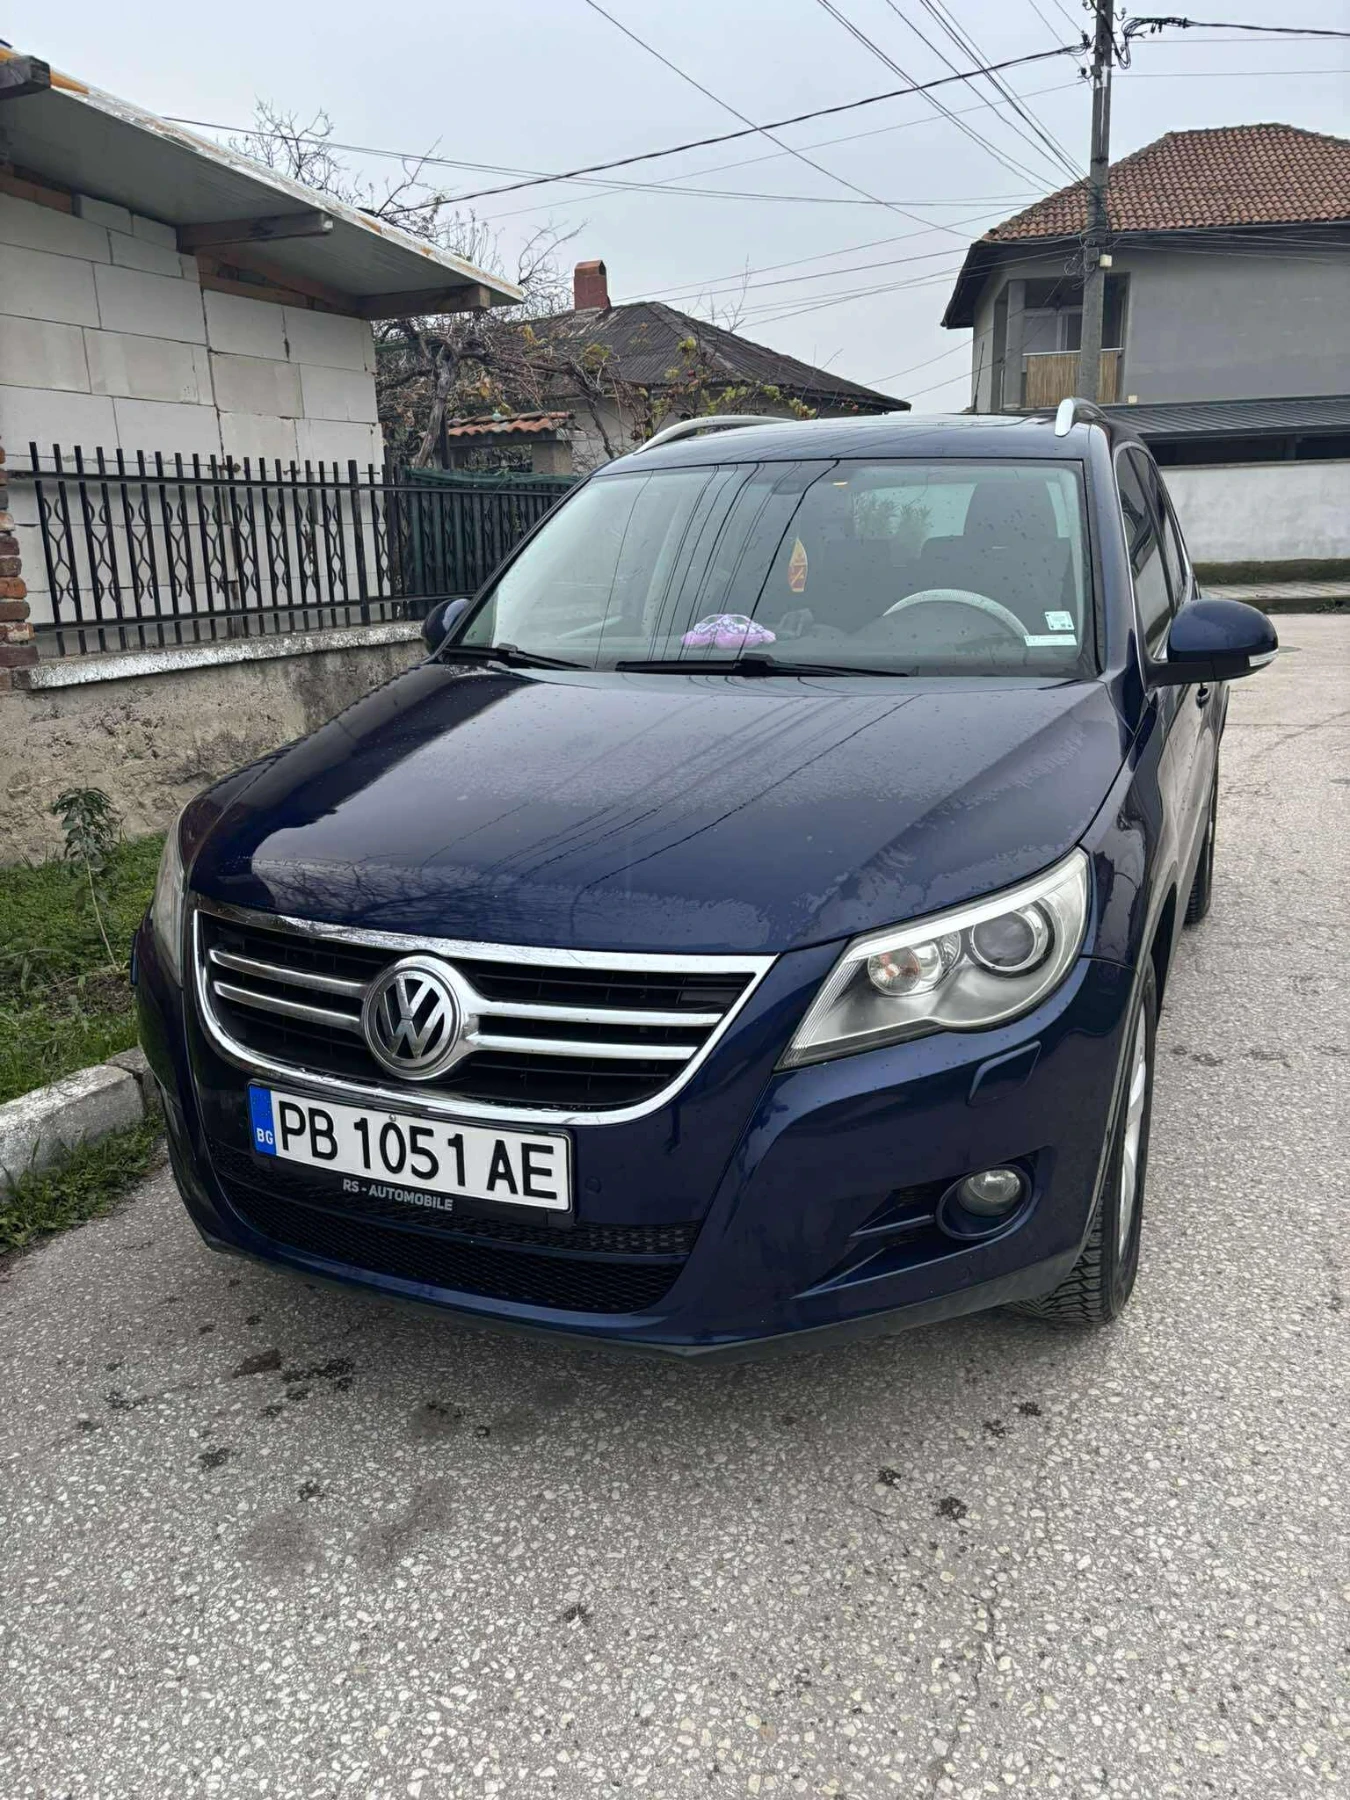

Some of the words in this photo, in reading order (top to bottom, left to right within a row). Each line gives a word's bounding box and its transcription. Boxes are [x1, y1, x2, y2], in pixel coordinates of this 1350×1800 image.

[371, 969, 453, 1066] VW
[256, 1127, 274, 1146] BG
[278, 1100, 338, 1161] PB
[353, 1117, 466, 1187] 1051
[486, 1139, 558, 1200] AE
